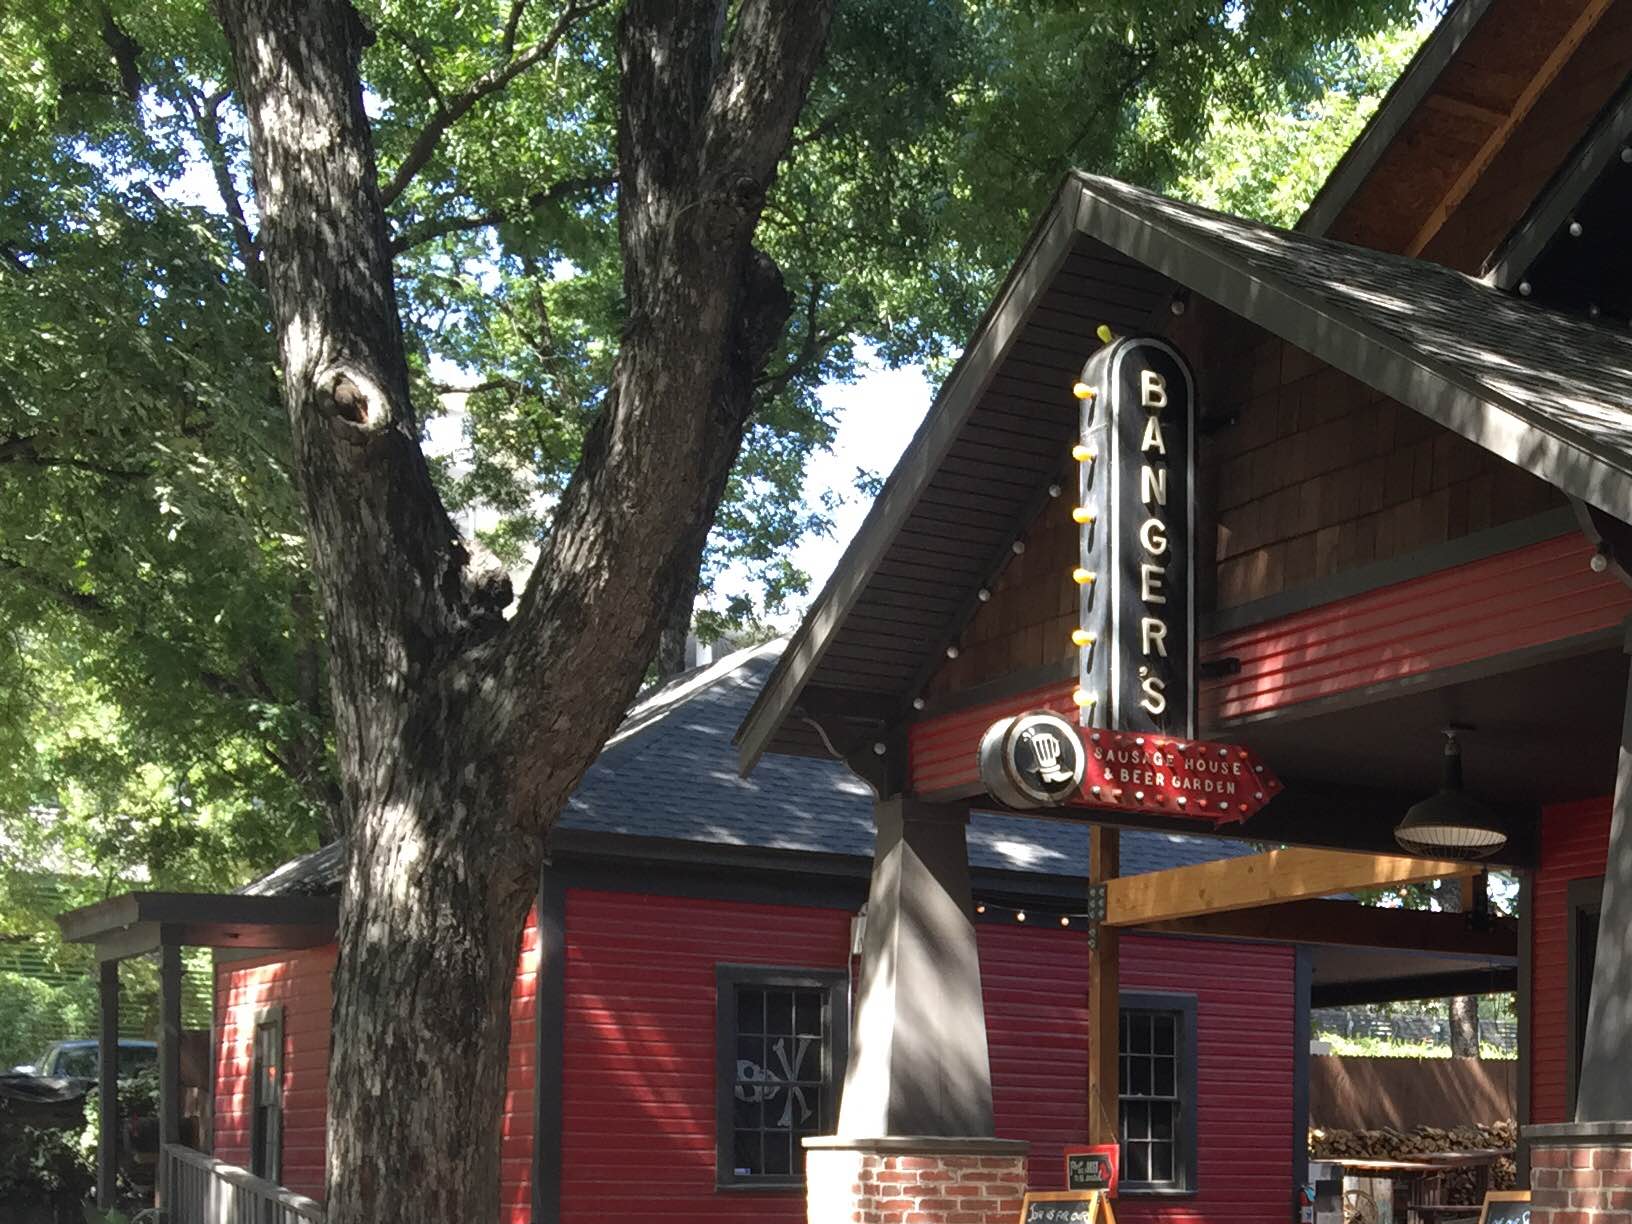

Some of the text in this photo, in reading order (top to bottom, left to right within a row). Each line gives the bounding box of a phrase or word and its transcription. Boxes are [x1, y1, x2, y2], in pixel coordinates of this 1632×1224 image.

[1139, 369, 1167, 717] BANGER'S
[1094, 747, 1242, 776] SAUSAGE HOUSE
[1104, 767, 1236, 795] & BEER GARDEN
